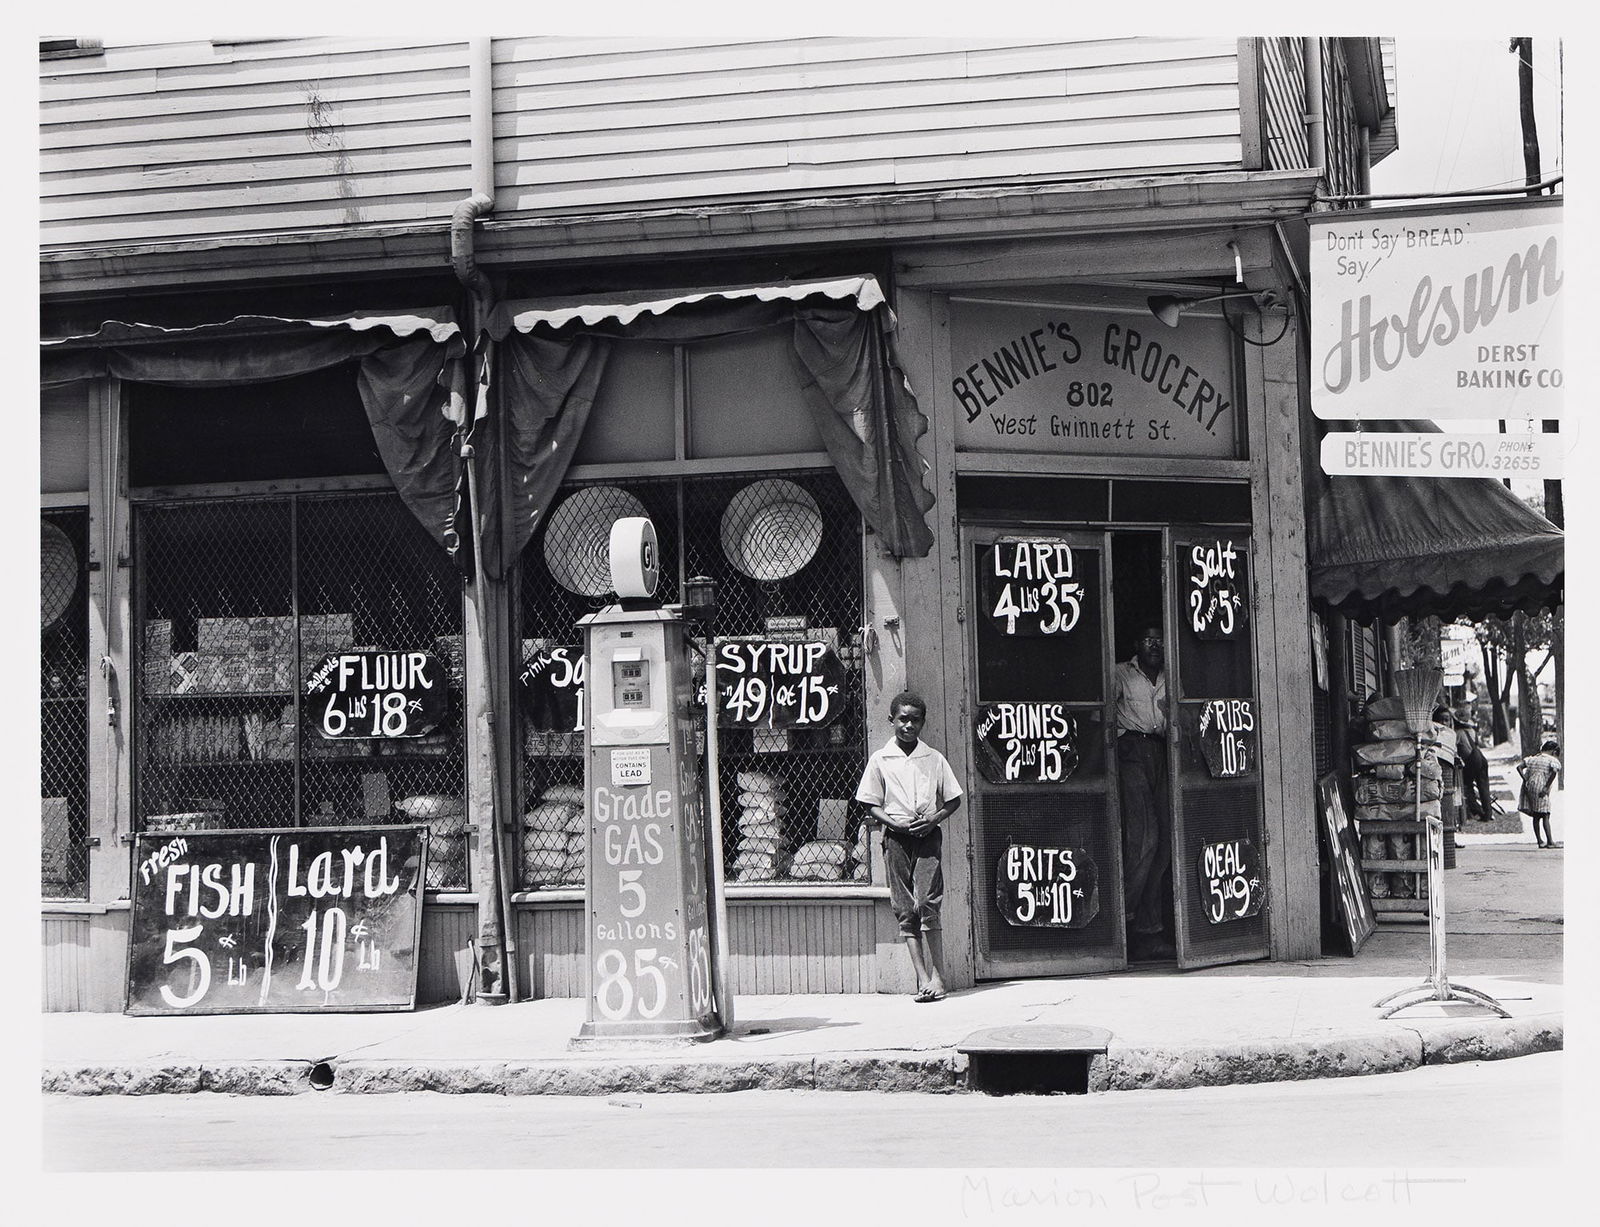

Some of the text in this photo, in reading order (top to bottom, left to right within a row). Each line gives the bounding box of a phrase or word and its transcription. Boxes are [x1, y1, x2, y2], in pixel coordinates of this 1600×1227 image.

[1327, 230, 1363, 251] Don't
[1371, 228, 1399, 258] Say
[1323, 235, 1564, 394] Holsum
[952, 322, 1081, 423] BENNIE'S
[1477, 344, 1539, 363] DERST
[1066, 381, 1114, 407] 802
[1456, 369, 1532, 388] BAKING
[991, 413, 1177, 440] West Gwinnett St.
[1345, 437, 1490, 469] BENNIE'S GRO.
[1498, 440, 1535, 453] PHONE
[995, 543, 1073, 582] LARD
[1190, 540, 1236, 588] Salt
[993, 583, 1020, 634] 4
[1190, 590, 1206, 633] 2
[339, 653, 433, 692] FLOUR
[551, 648, 585, 687] Sa
[716, 643, 827, 675] SYRUP
[323, 693, 347, 736] 6
[998, 703, 1068, 740] BONES
[1213, 700, 1253, 732] RIBS
[620, 769, 642, 778] LEAD
[1005, 739, 1021, 780] 2
[594, 787, 672, 823] Grade
[605, 823, 664, 865] GAS
[1204, 842, 1246, 878] MEAL
[139, 836, 255, 919] Fresh FISH
[288, 836, 399, 899] Lard
[1007, 847, 1077, 881] GRITS
[618, 870, 647, 918] 5
[1017, 883, 1035, 922] 5
[1210, 879, 1224, 922] 5
[597, 921, 677, 941] Gallons
